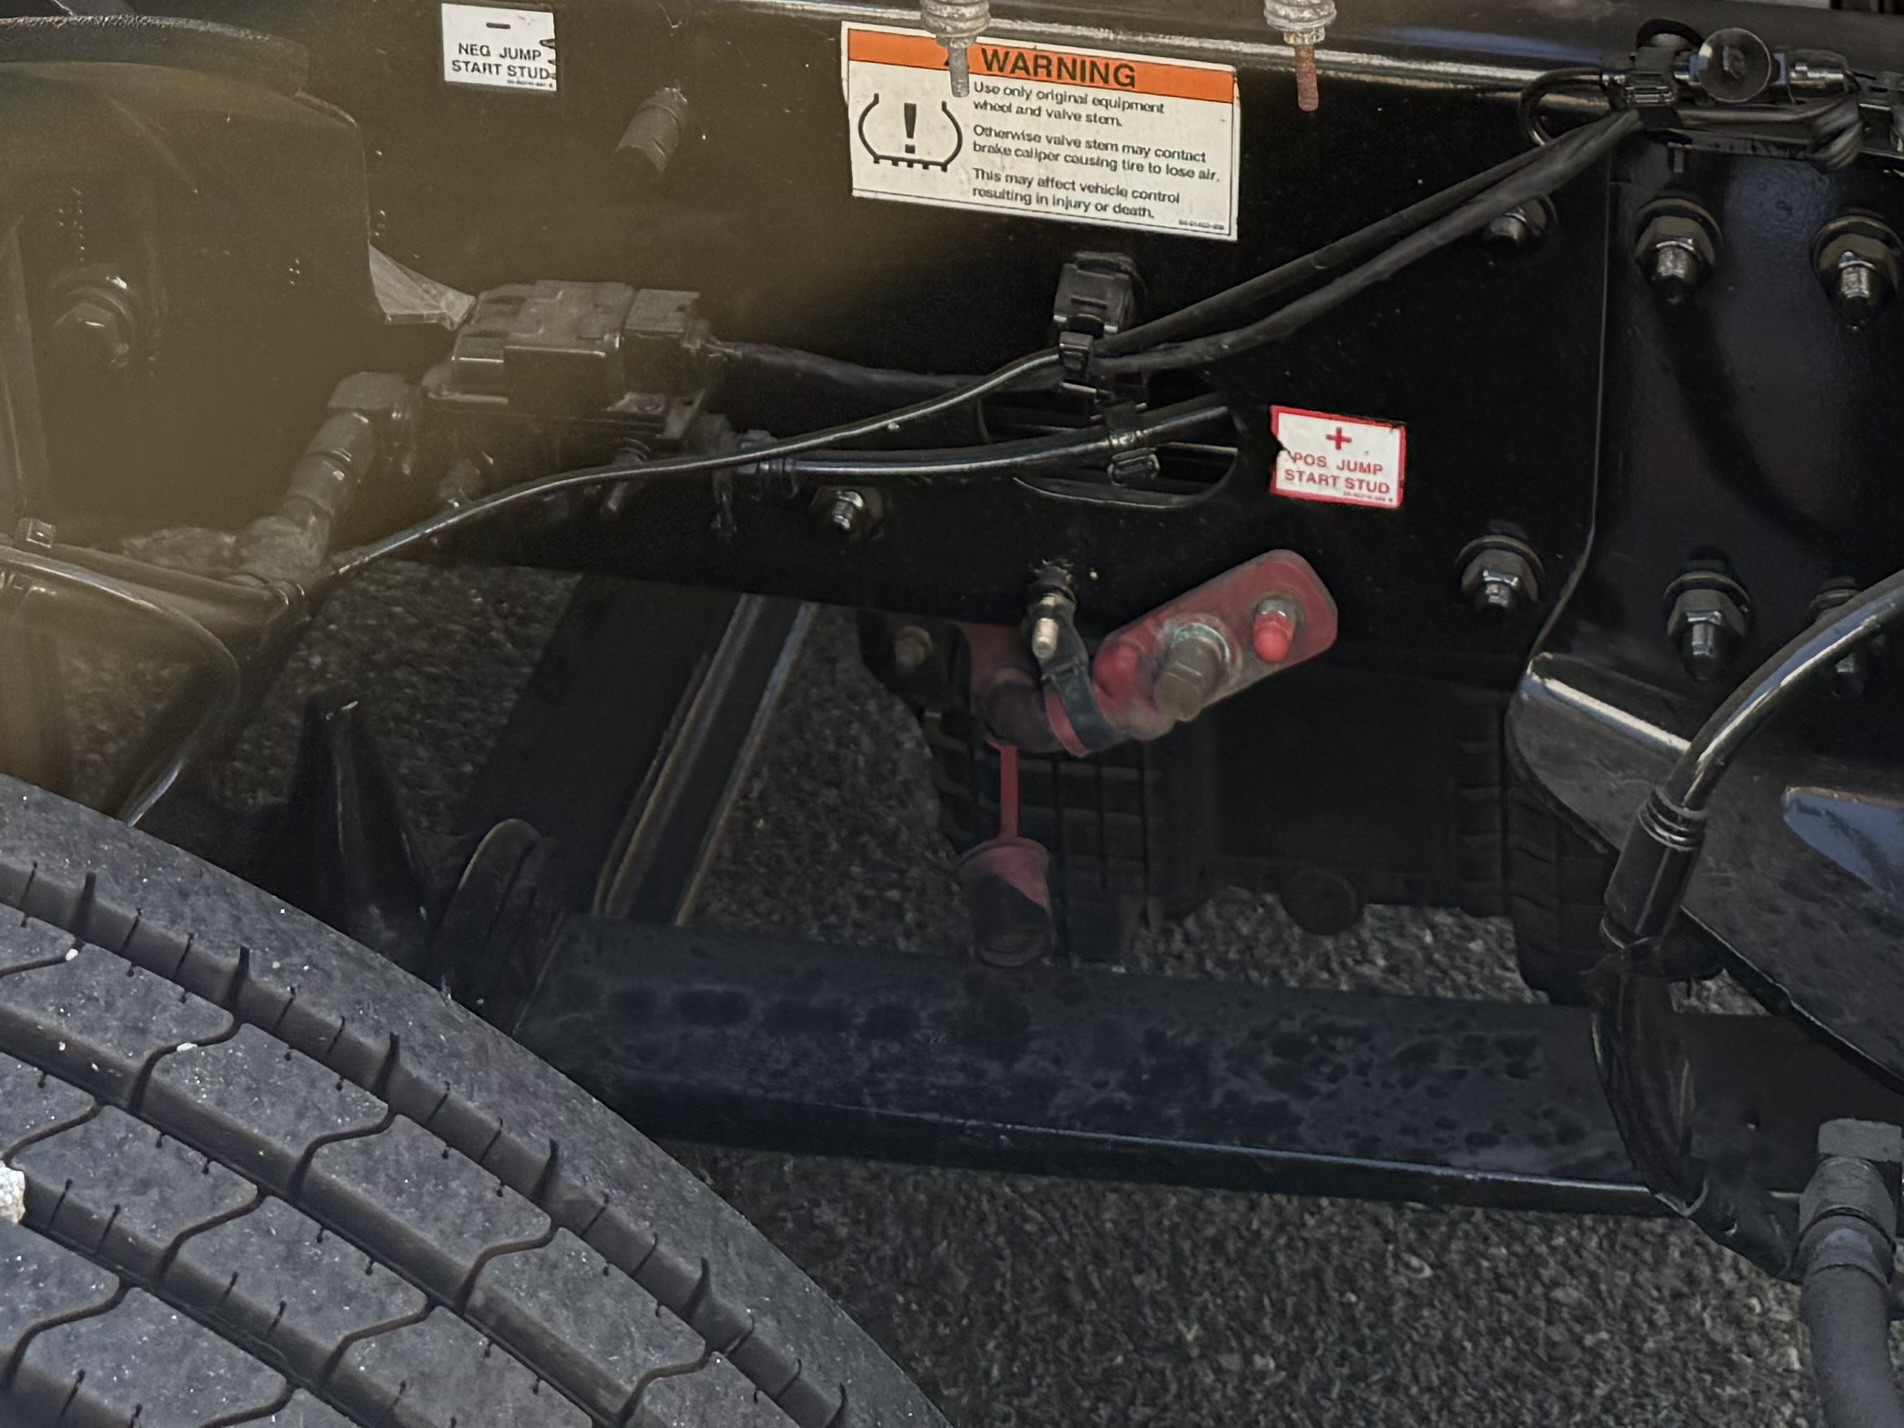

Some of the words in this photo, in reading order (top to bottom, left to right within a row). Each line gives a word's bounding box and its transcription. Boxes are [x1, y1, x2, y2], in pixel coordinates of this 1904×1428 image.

[458, 42, 491, 58] NEG
[499, 46, 543, 62] JUMP
[981, 47, 1136, 89] WARNING
[451, 59, 502, 76] START
[507, 64, 551, 81] STUD
[973, 81, 1001, 95] Use
[1003, 85, 1033, 102] only
[1036, 88, 1089, 106] original
[1091, 95, 1166, 116] equipment
[973, 100, 1013, 115] wheel
[1015, 104, 1042, 118] and
[1045, 108, 1083, 123] valve
[1085, 112, 1123, 128] stem.
[973, 124, 1042, 144] Otherwise
[1046, 134, 1082, 149] valve
[1085, 139, 1119, 153] stem
[1122, 144, 1152, 160] may
[1153, 146, 1207, 164] contact
[973, 143, 1012, 158] brake
[1014, 147, 1061, 164] caliper
[1063, 153, 1118, 173] causing
[1122, 159, 1145, 174] tire
[1148, 162, 1163, 175] to
[1165, 164, 1196, 180] lose
[1198, 168, 1222, 183] air.
[973, 167, 1001, 183] This
[1004, 173, 1035, 189] may
[1037, 176, 1077, 193] affect
[1079, 181, 1129, 199] vehicle
[1131, 188, 1181, 205] control
[973, 186, 1033, 206] resulting
[1036, 192, 1049, 206] in
[1052, 192, 1092, 213] injury
[1094, 201, 1110, 213] or
[1112, 203, 1156, 220] death.
[1293, 451, 1328, 469] POS
[1336, 459, 1384, 476] JUMP
[1284, 468, 1341, 488] START
[1344, 477, 1391, 495] STUD
